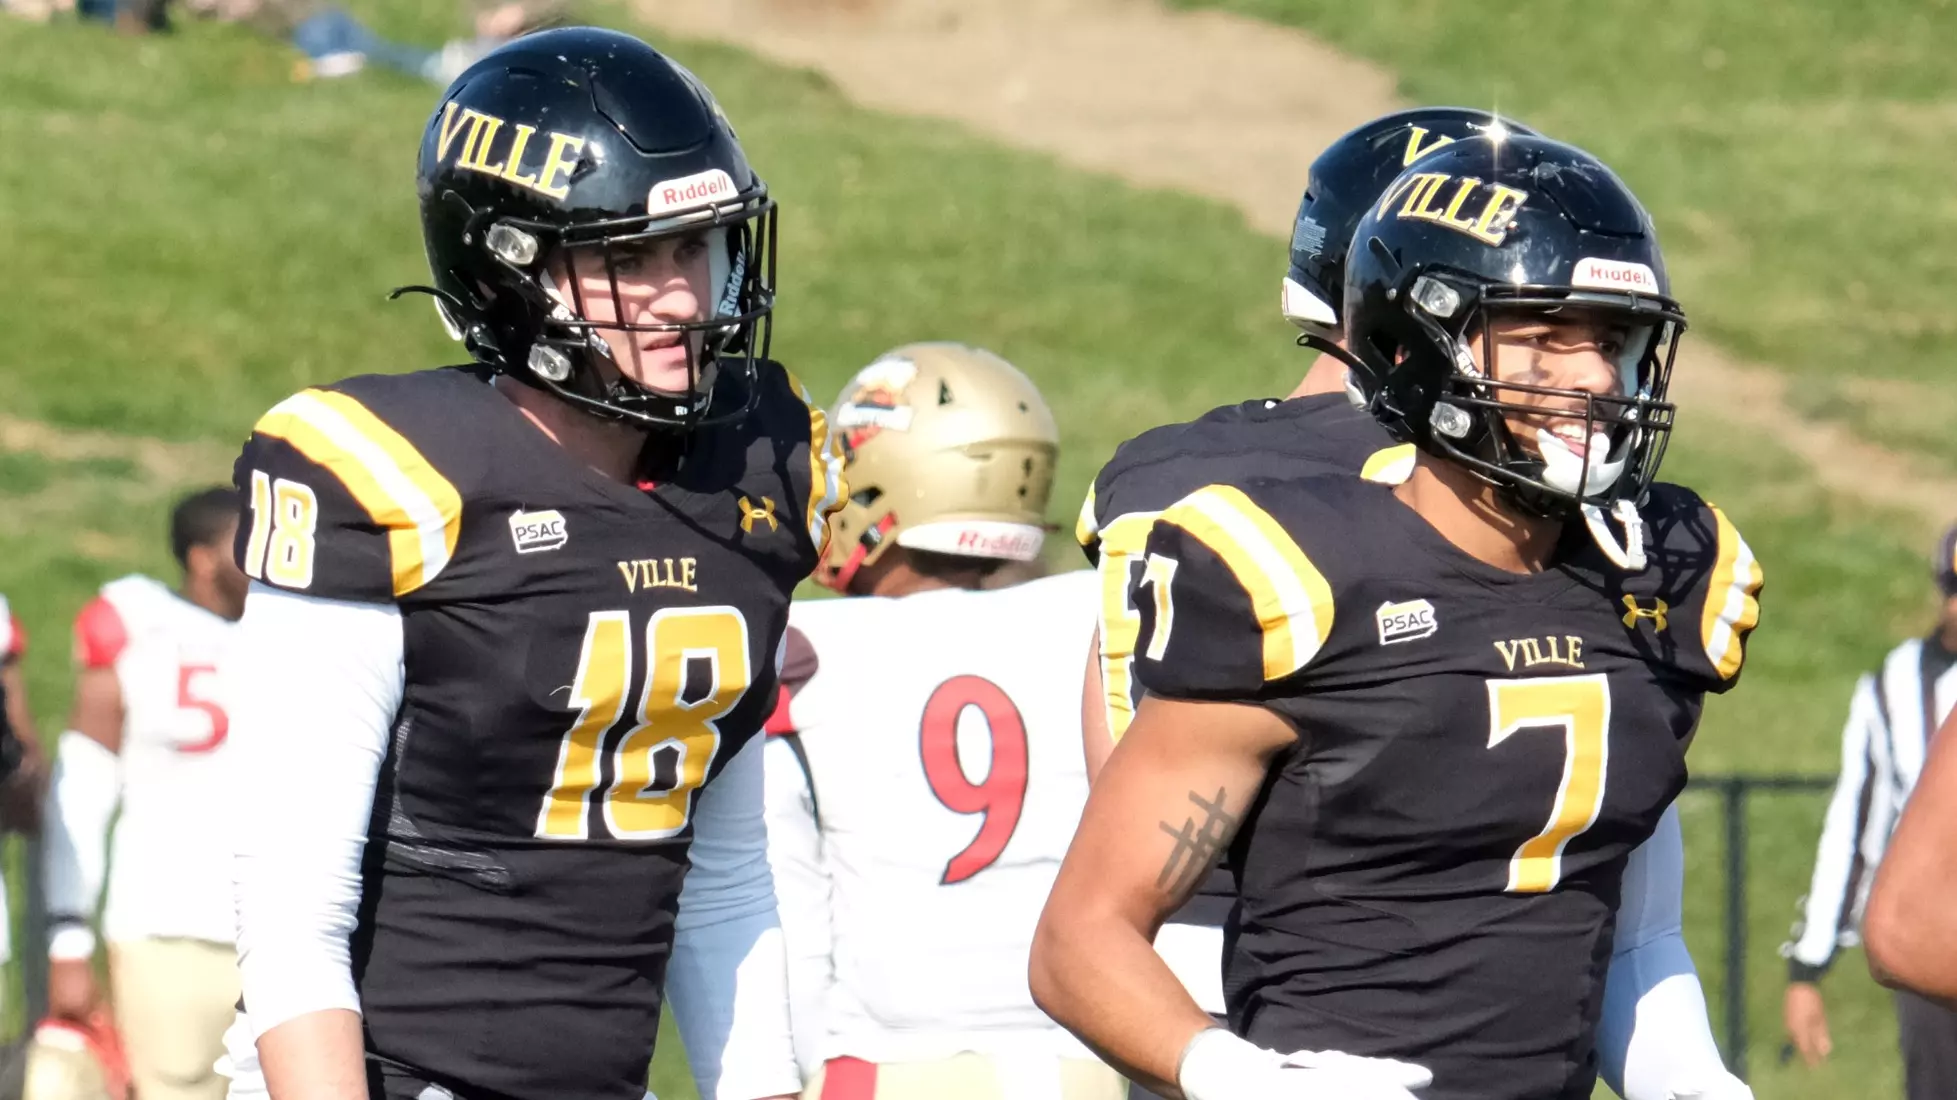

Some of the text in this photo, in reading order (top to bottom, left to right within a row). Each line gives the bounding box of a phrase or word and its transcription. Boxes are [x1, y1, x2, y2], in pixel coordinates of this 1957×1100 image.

[436, 101, 585, 200] VILLE
[662, 173, 728, 205] Riddell
[1376, 171, 1529, 248] VILLE
[717, 250, 745, 317] Riddell
[244, 469, 318, 590] 18
[513, 518, 565, 543] PSAC
[617, 557, 698, 594] VILLE
[1381, 610, 1434, 636] PSAC
[1494, 635, 1586, 671] VILLE
[175, 664, 230, 754] 5
[533, 604, 752, 841] 18
[919, 673, 1029, 886] 9
[1485, 672, 1610, 893] 7
